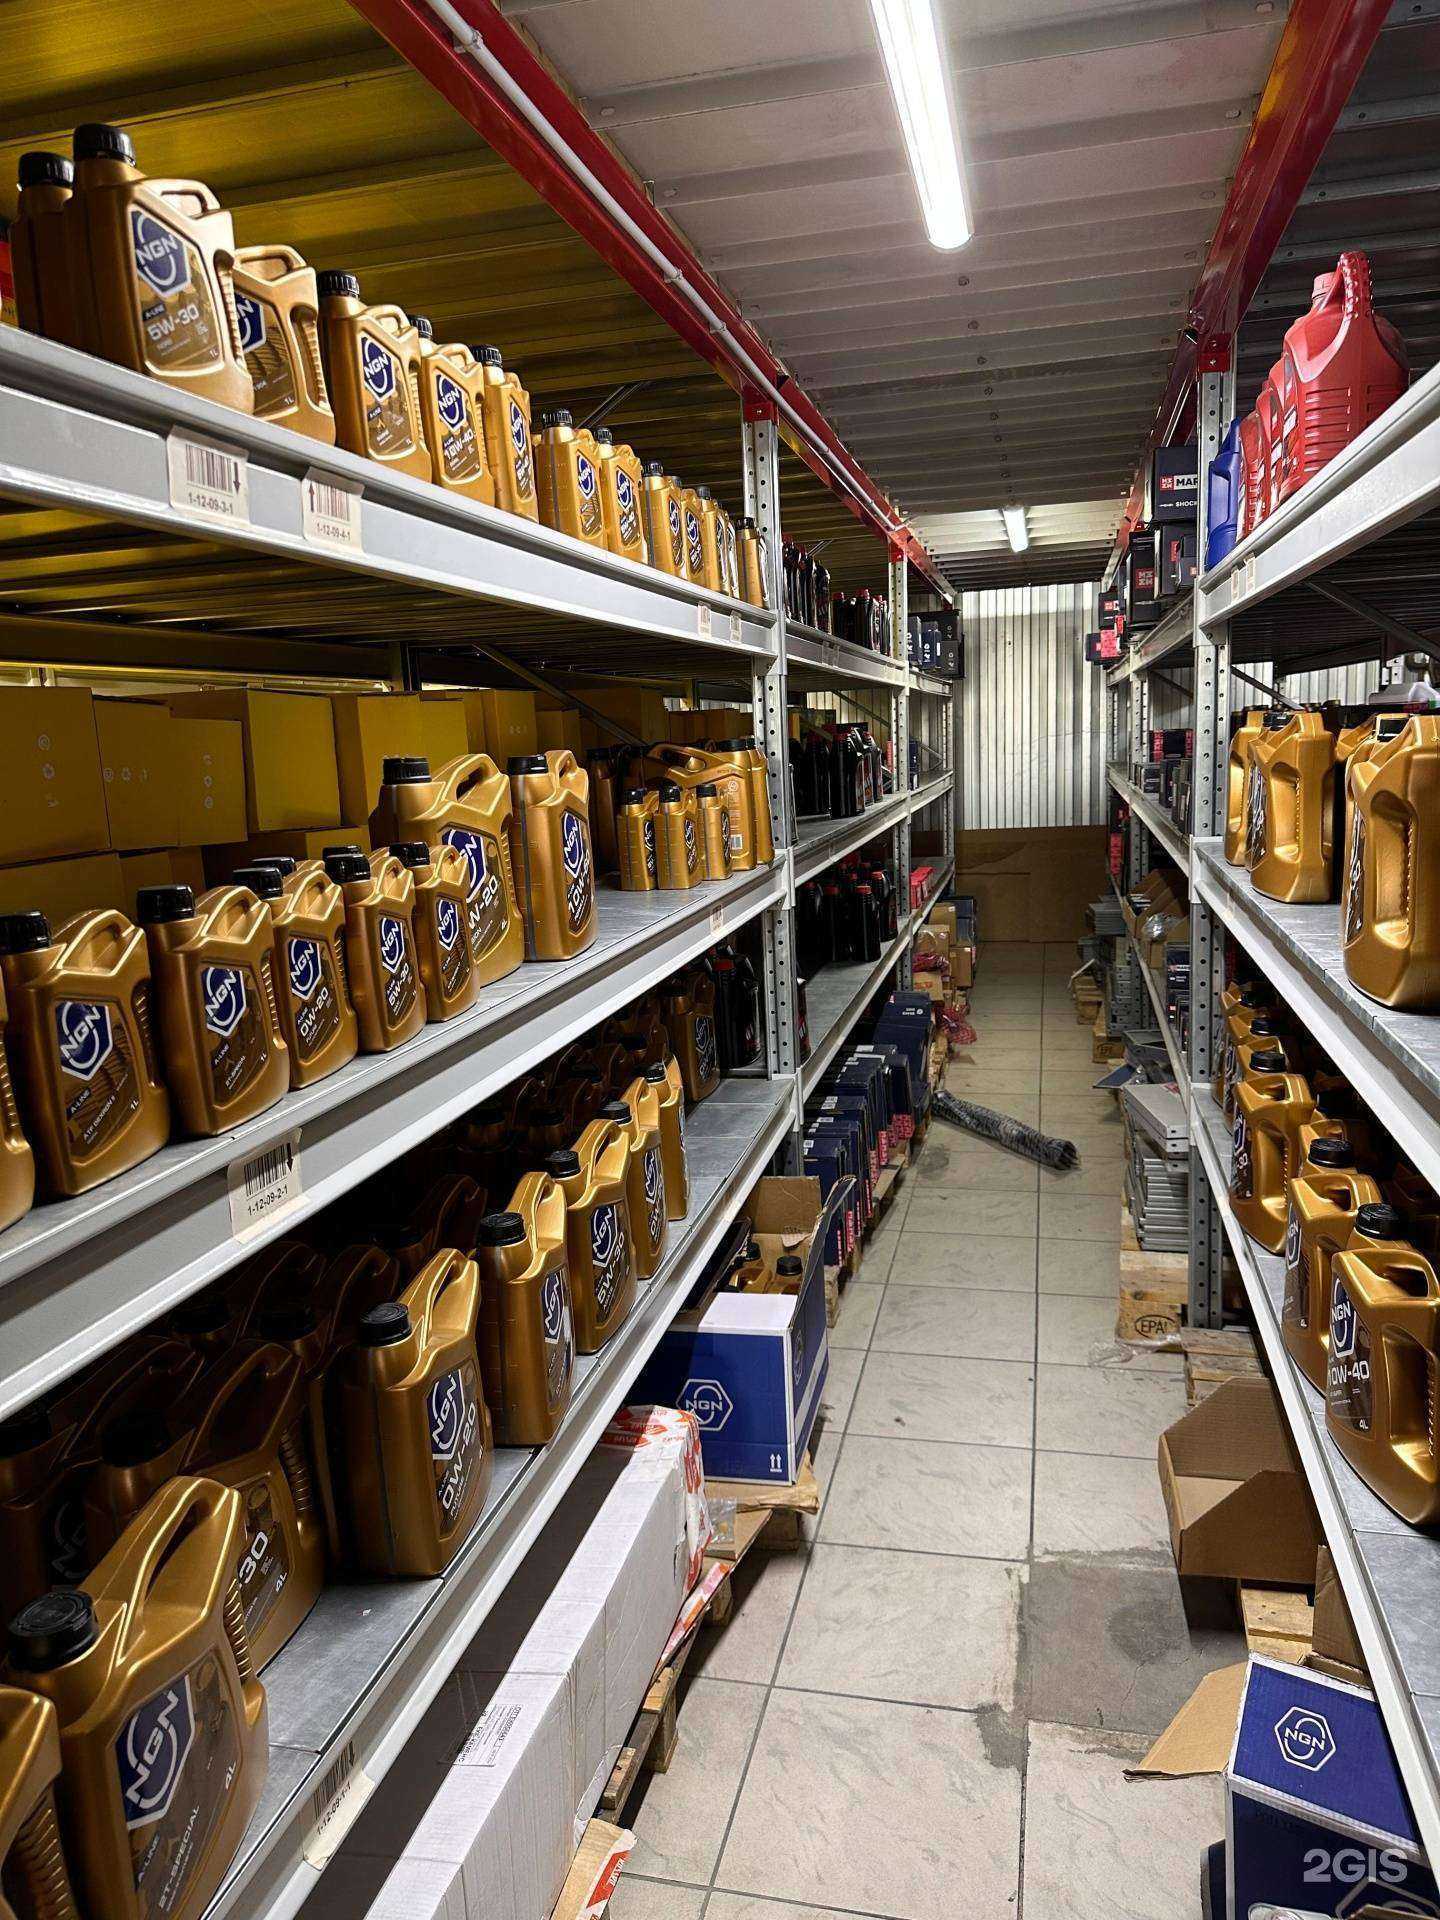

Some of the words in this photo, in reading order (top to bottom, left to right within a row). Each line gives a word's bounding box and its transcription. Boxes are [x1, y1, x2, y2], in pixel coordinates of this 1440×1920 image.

[136, 234, 178, 265] NGN
[147, 303, 200, 341] 5W-30
[364, 353, 389, 379] NGN
[438, 386, 461, 411] NGN
[188, 491, 234, 515] 1-12-09-3-1
[316, 522, 351, 541] 1-12-09-4-1
[564, 825, 578, 857] NGN
[468, 874, 499, 930] W-20
[438, 904, 455, 934] NGN
[381, 922, 399, 956] NGN
[290, 943, 315, 982] NGN
[205, 970, 237, 1018] NGN
[300, 986, 329, 1037] 0W-20
[60, 1006, 101, 1058] NGN
[70, 1089, 90, 1115] A-LINE
[129, 1099, 140, 1111] 1L
[247, 1184, 289, 1216] 1-12-09-2-1
[592, 1206, 613, 1254] NGN
[598, 1231, 625, 1305] 5W-30
[545, 1273, 560, 1325] NGN
[1331, 1300, 1352, 1321] NGN
[432, 1376, 457, 1444] NGN
[685, 1399, 723, 1412] NGN
[442, 1401, 476, 1510] 0W-20
[275, 1571, 288, 1593] 4L
[126, 1689, 179, 1804] NGN
[1284, 1726, 1325, 1751] NGN
[224, 1760, 237, 1790] 4L
[317, 1780, 351, 1835] 1-12-09-1-1
